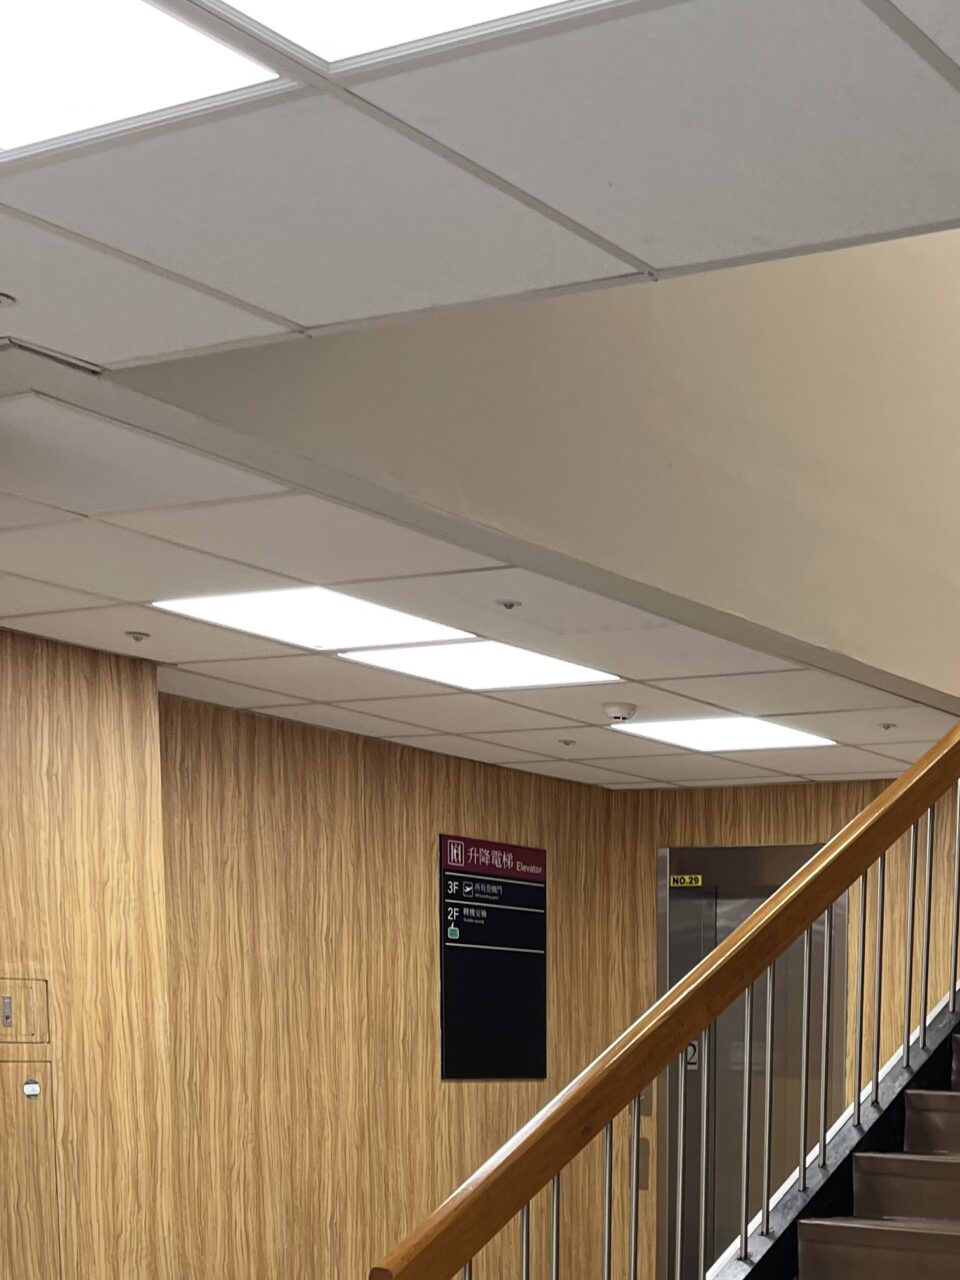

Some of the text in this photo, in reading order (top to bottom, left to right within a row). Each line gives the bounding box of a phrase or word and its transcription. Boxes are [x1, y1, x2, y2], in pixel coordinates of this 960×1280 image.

[467, 847, 514, 870] 升降電梯
[516, 861, 543, 874] Elevator
[672, 876, 699, 885] NO.29
[447, 881, 459, 894] 3F
[447, 907, 459, 920] 2F
